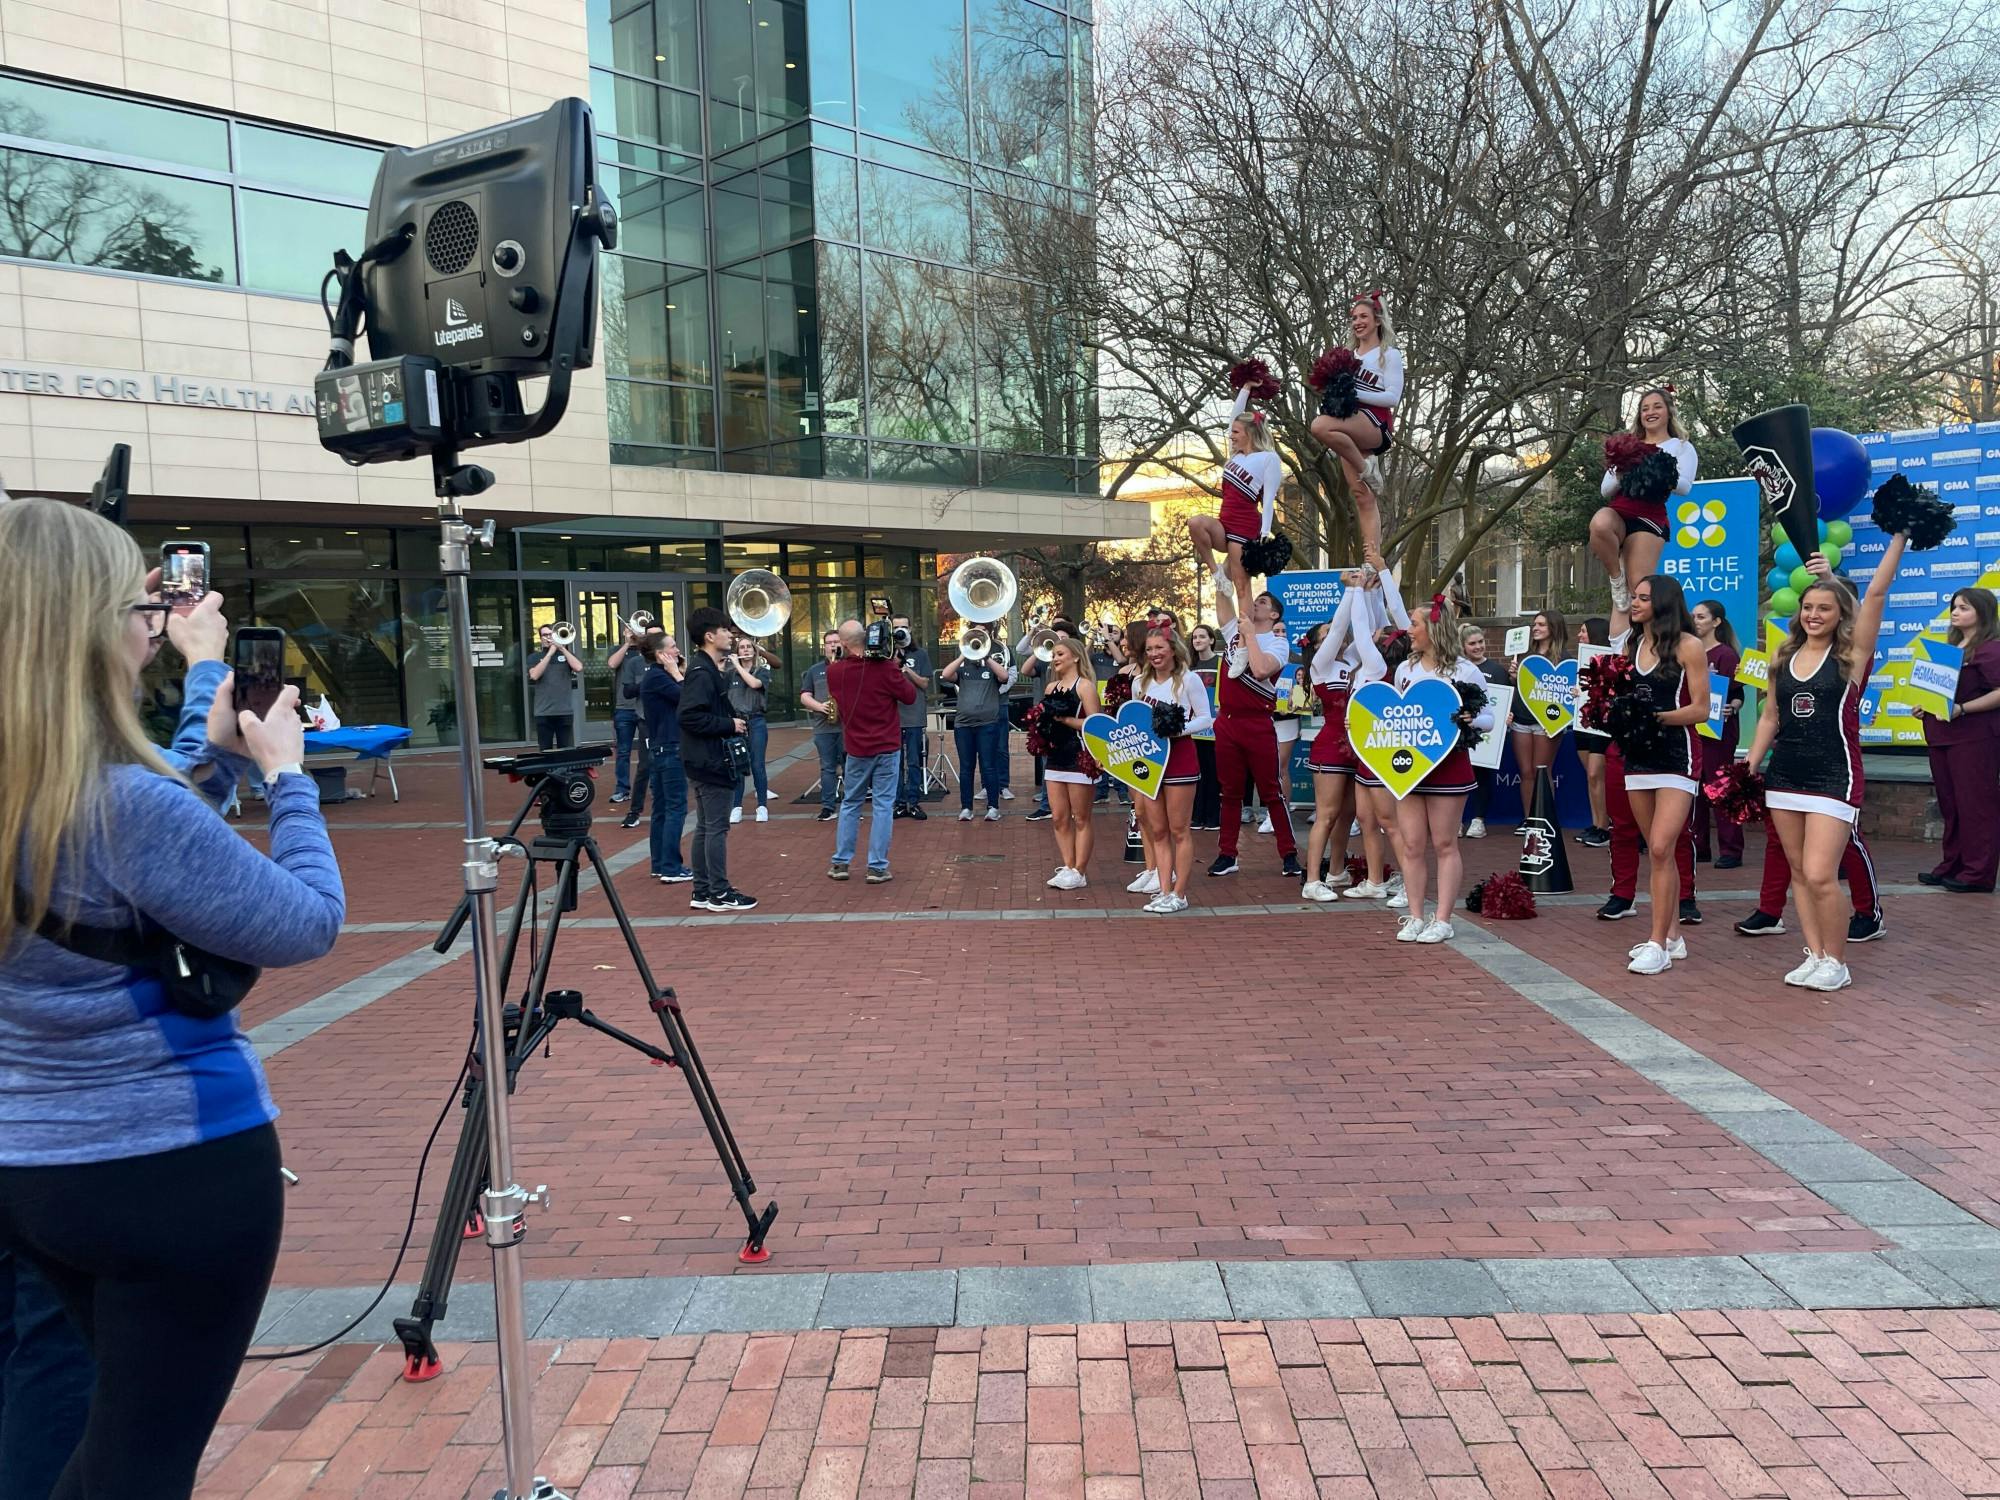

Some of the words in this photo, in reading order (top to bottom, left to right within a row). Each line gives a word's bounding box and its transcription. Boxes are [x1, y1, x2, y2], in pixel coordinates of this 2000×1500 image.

[434, 323, 484, 347] Litepanels
[77, 374, 140, 400] FOR
[154, 374, 273, 411] HEALTH
[1945, 424, 1970, 435] GMA
[1862, 434, 1886, 445] GMA
[1902, 457, 1927, 468] GMA
[1944, 480, 1970, 491] GMA
[1943, 537, 1969, 547] GMA
[1860, 543, 1885, 553] GMA
[1664, 558, 1691, 574] BE
[1696, 556, 1739, 573] THE
[1901, 567, 1926, 578] GMA
[1288, 583, 1312, 591] YOUR
[1314, 582, 1338, 590] ODDS
[1681, 575, 1739, 592] ATCH
[1283, 591, 1296, 599] OF
[1297, 589, 1333, 598] FINDING
[1334, 589, 1342, 597] A
[1286, 597, 1340, 606] LIFE-SAVING
[1298, 605, 1329, 613] MATCH
[1900, 623, 1924, 632] GMA
[1542, 673, 1568, 685] GOOD
[1535, 680, 1573, 692] MORNING
[1383, 704, 1423, 718] GOOD
[1372, 717, 1433, 731] MORNING
[1109, 724, 1137, 740] GOOD
[1897, 731, 1922, 741] GMA
[1106, 732, 1148, 752] MORNING
[1364, 729, 1443, 749] AMERICA
[1107, 740, 1161, 767] AMERICA
[1393, 756, 1412, 765] abc
[1134, 766, 1148, 775] abc
[1496, 773, 1559, 788] MAH
